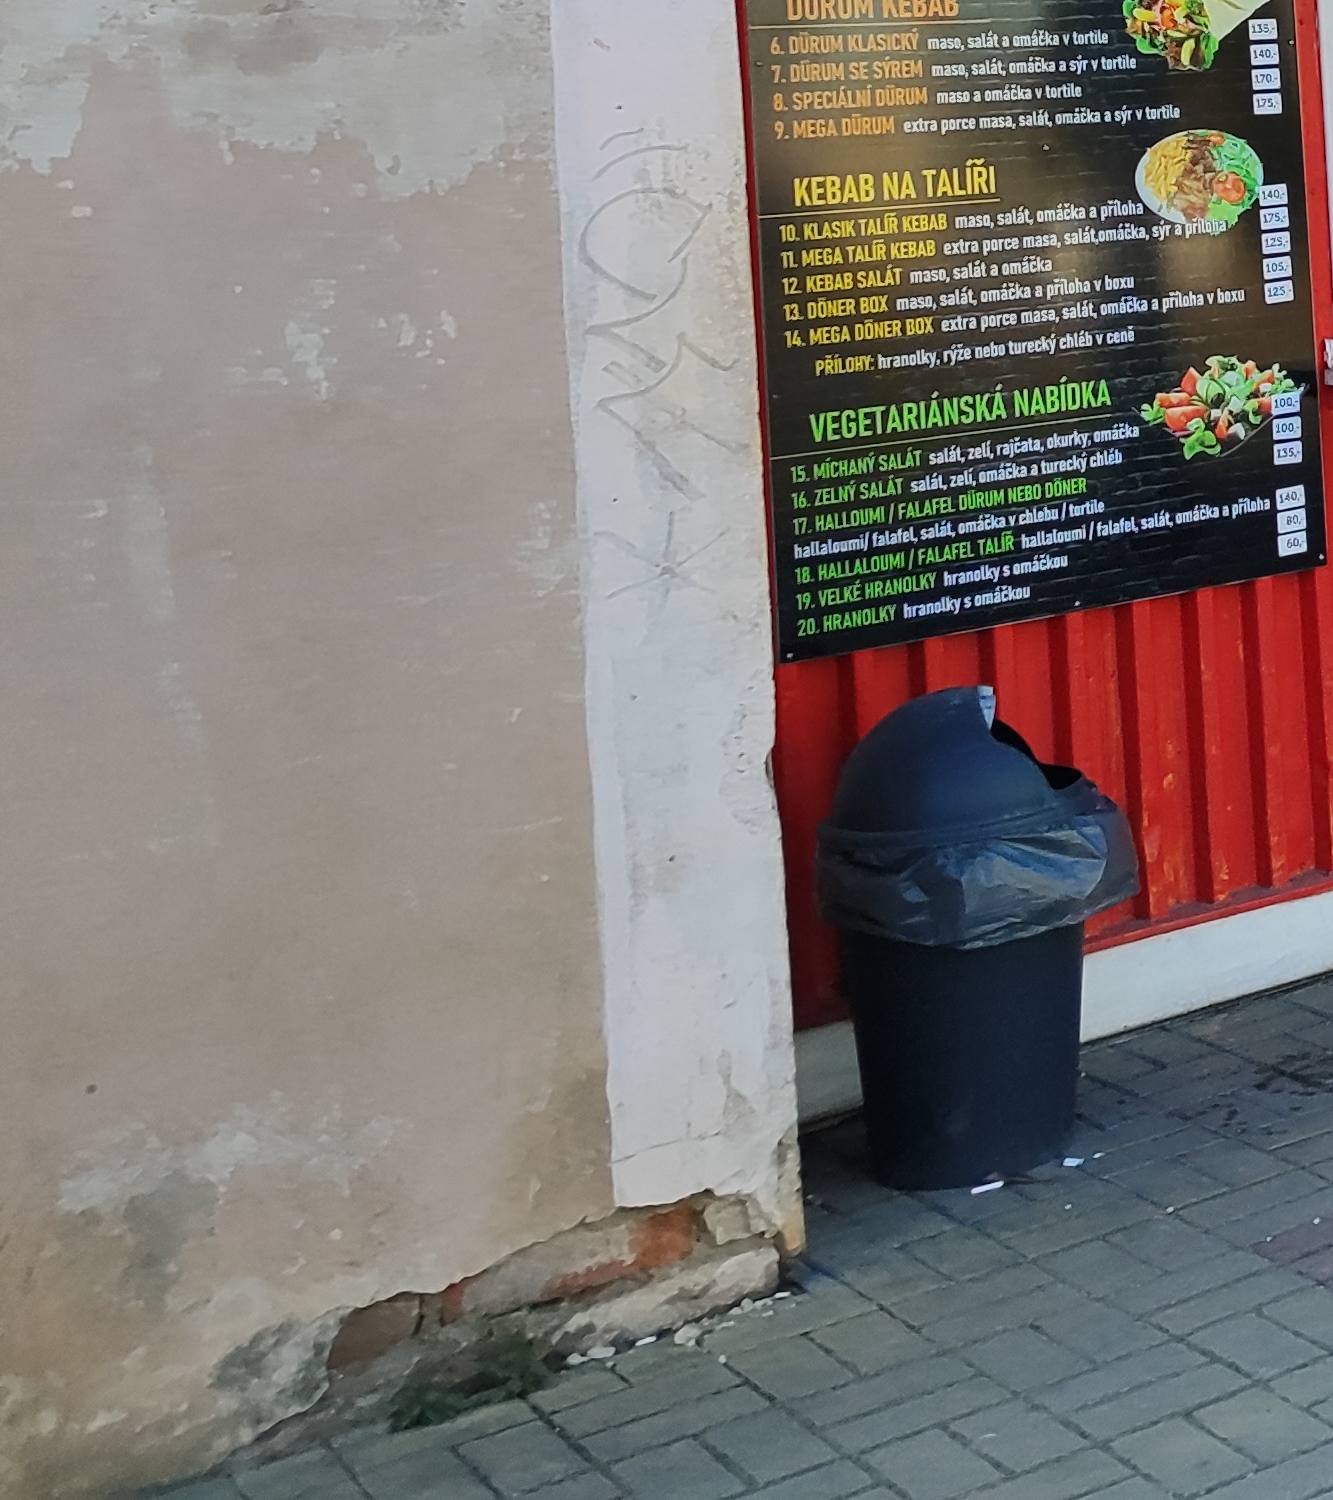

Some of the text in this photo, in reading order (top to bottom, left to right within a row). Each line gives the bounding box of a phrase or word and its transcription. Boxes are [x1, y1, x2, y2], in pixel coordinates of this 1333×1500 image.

[770, 36, 785, 55] 6.
[788, 30, 844, 54] DÜRUM
[847, 28, 920, 52] KLASICKÝ
[966, 30, 1000, 49] salát
[1012, 29, 1059, 47] omáčka
[1072, 28, 1109, 45] tortile
[771, 63, 786, 83] 7.
[789, 58, 845, 82] DÜRUM
[848, 60, 869, 80] SE
[872, 55, 923, 79] SÝREM
[1008, 55, 1056, 74] omáčka
[1068, 54, 1089, 75] sýr
[1100, 53, 1136, 70] tortile
[773, 91, 788, 111] 8.
[791, 84, 871, 110] SPECIÁLNÍ
[874, 83, 928, 106] DÜRUM
[936, 90, 970, 104] maso
[984, 83, 1032, 102] omáčka
[1045, 81, 1082, 99] tortile
[793, 158, 996, 207] KEBAB NA TALÍŘI
[779, 224, 800, 243] 10.
[803, 219, 856, 241] KLASIK
[857, 212, 898, 237] TALÍŘ
[902, 213, 947, 233] KEBAB
[1036, 204, 1086, 223] omáčka
[1100, 200, 1146, 221] příloha
[781, 276, 802, 295] 12.
[805, 271, 854, 293] KEBAB
[856, 264, 903, 288] SALÁT
[952, 261, 987, 280] salát
[1001, 256, 1052, 276] omáčka
[783, 303, 804, 322] 13.
[806, 296, 856, 319] DÖNER
[859, 295, 889, 314] BOX
[980, 283, 1031, 303] omáčka
[1046, 278, 1091, 300] příloha
[1104, 275, 1134, 291] boxu
[815, 353, 875, 377] PŘÍLOHY:
[943, 344, 972, 365] rýže
[974, 341, 1006, 359] nebo
[1007, 334, 1057, 356] turecký
[1057, 331, 1093, 350] chléb
[1106, 326, 1135, 345] ceně
[809, 377, 1111, 443] VEGETARIÁNSKÁ NABÍDKA
[790, 465, 810, 484] 15.
[813, 452, 876, 480] MÍCHANÝ
[878, 447, 922, 472] SALÁT
[1093, 424, 1139, 443] omáčka
[791, 491, 811, 510] 16.
[813, 480, 857, 507] ZELNÝ
[859, 475, 904, 500] SALÁT
[978, 463, 1028, 484] omáčka
[1040, 453, 1088, 475] turecký
[1089, 449, 1122, 468] chléb
[792, 517, 812, 536] 17.
[815, 506, 885, 533] HALLOUMI
[897, 496, 956, 520] FALAFEL
[958, 489, 1005, 511] DÜRUM
[1007, 483, 1042, 504] NEBO
[1044, 477, 1087, 499] DÖNER
[795, 592, 815, 611] 19.
[818, 580, 862, 608] VELKÉ
[864, 572, 936, 600] HRANOLKY
[943, 564, 1001, 587] hranolky
[1012, 554, 1068, 576] omáčkou
[797, 618, 819, 637] 20.
[823, 604, 896, 633] HRANOLKY
[903, 595, 962, 619] hranolky
[974, 585, 1030, 607] omáčkou
